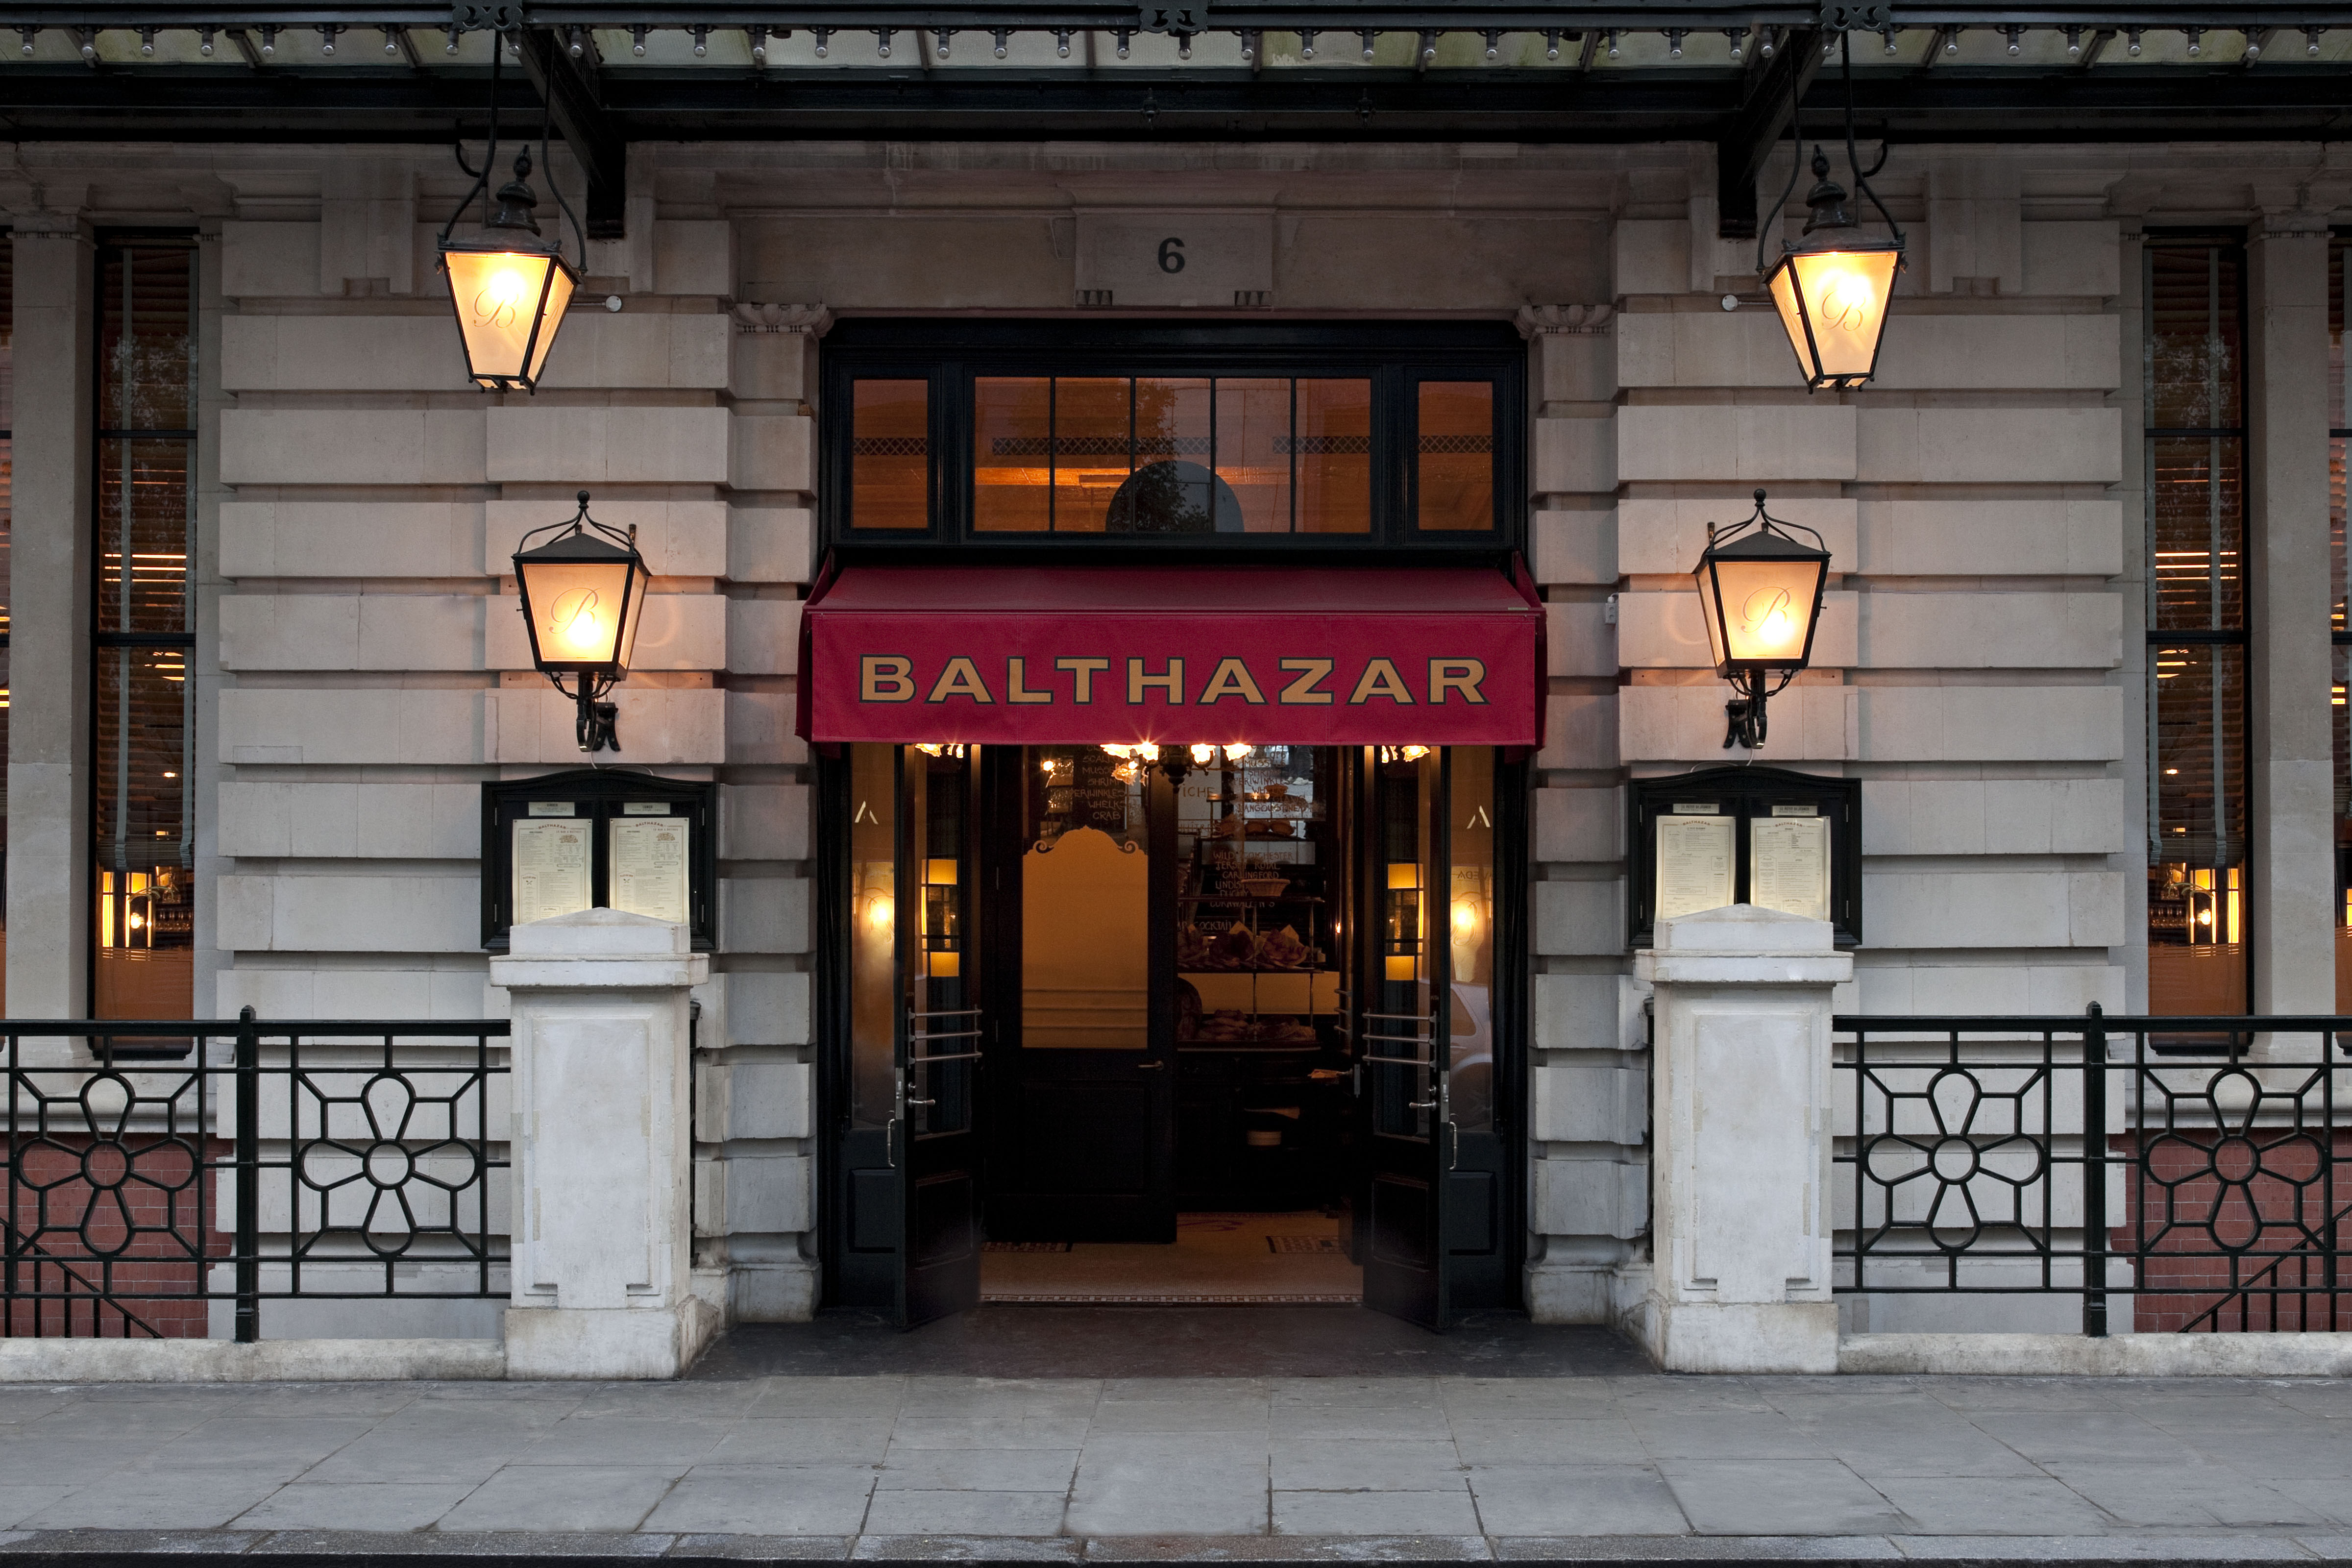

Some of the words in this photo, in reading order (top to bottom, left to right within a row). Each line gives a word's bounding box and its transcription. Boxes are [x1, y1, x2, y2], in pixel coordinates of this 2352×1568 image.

[1157, 237, 1185, 274] 6
[549, 587, 603, 634] B
[1740, 586, 1794, 633] B
[858, 653, 1491, 706] BALTHAZAR
[1180, 784, 1216, 797] ICHE
[1088, 800, 1126, 810] WHELKS
[1093, 811, 1121, 821] CRAB
[1213, 850, 1235, 859] WILD
[1222, 871, 1279, 879] CARLINGFORD
